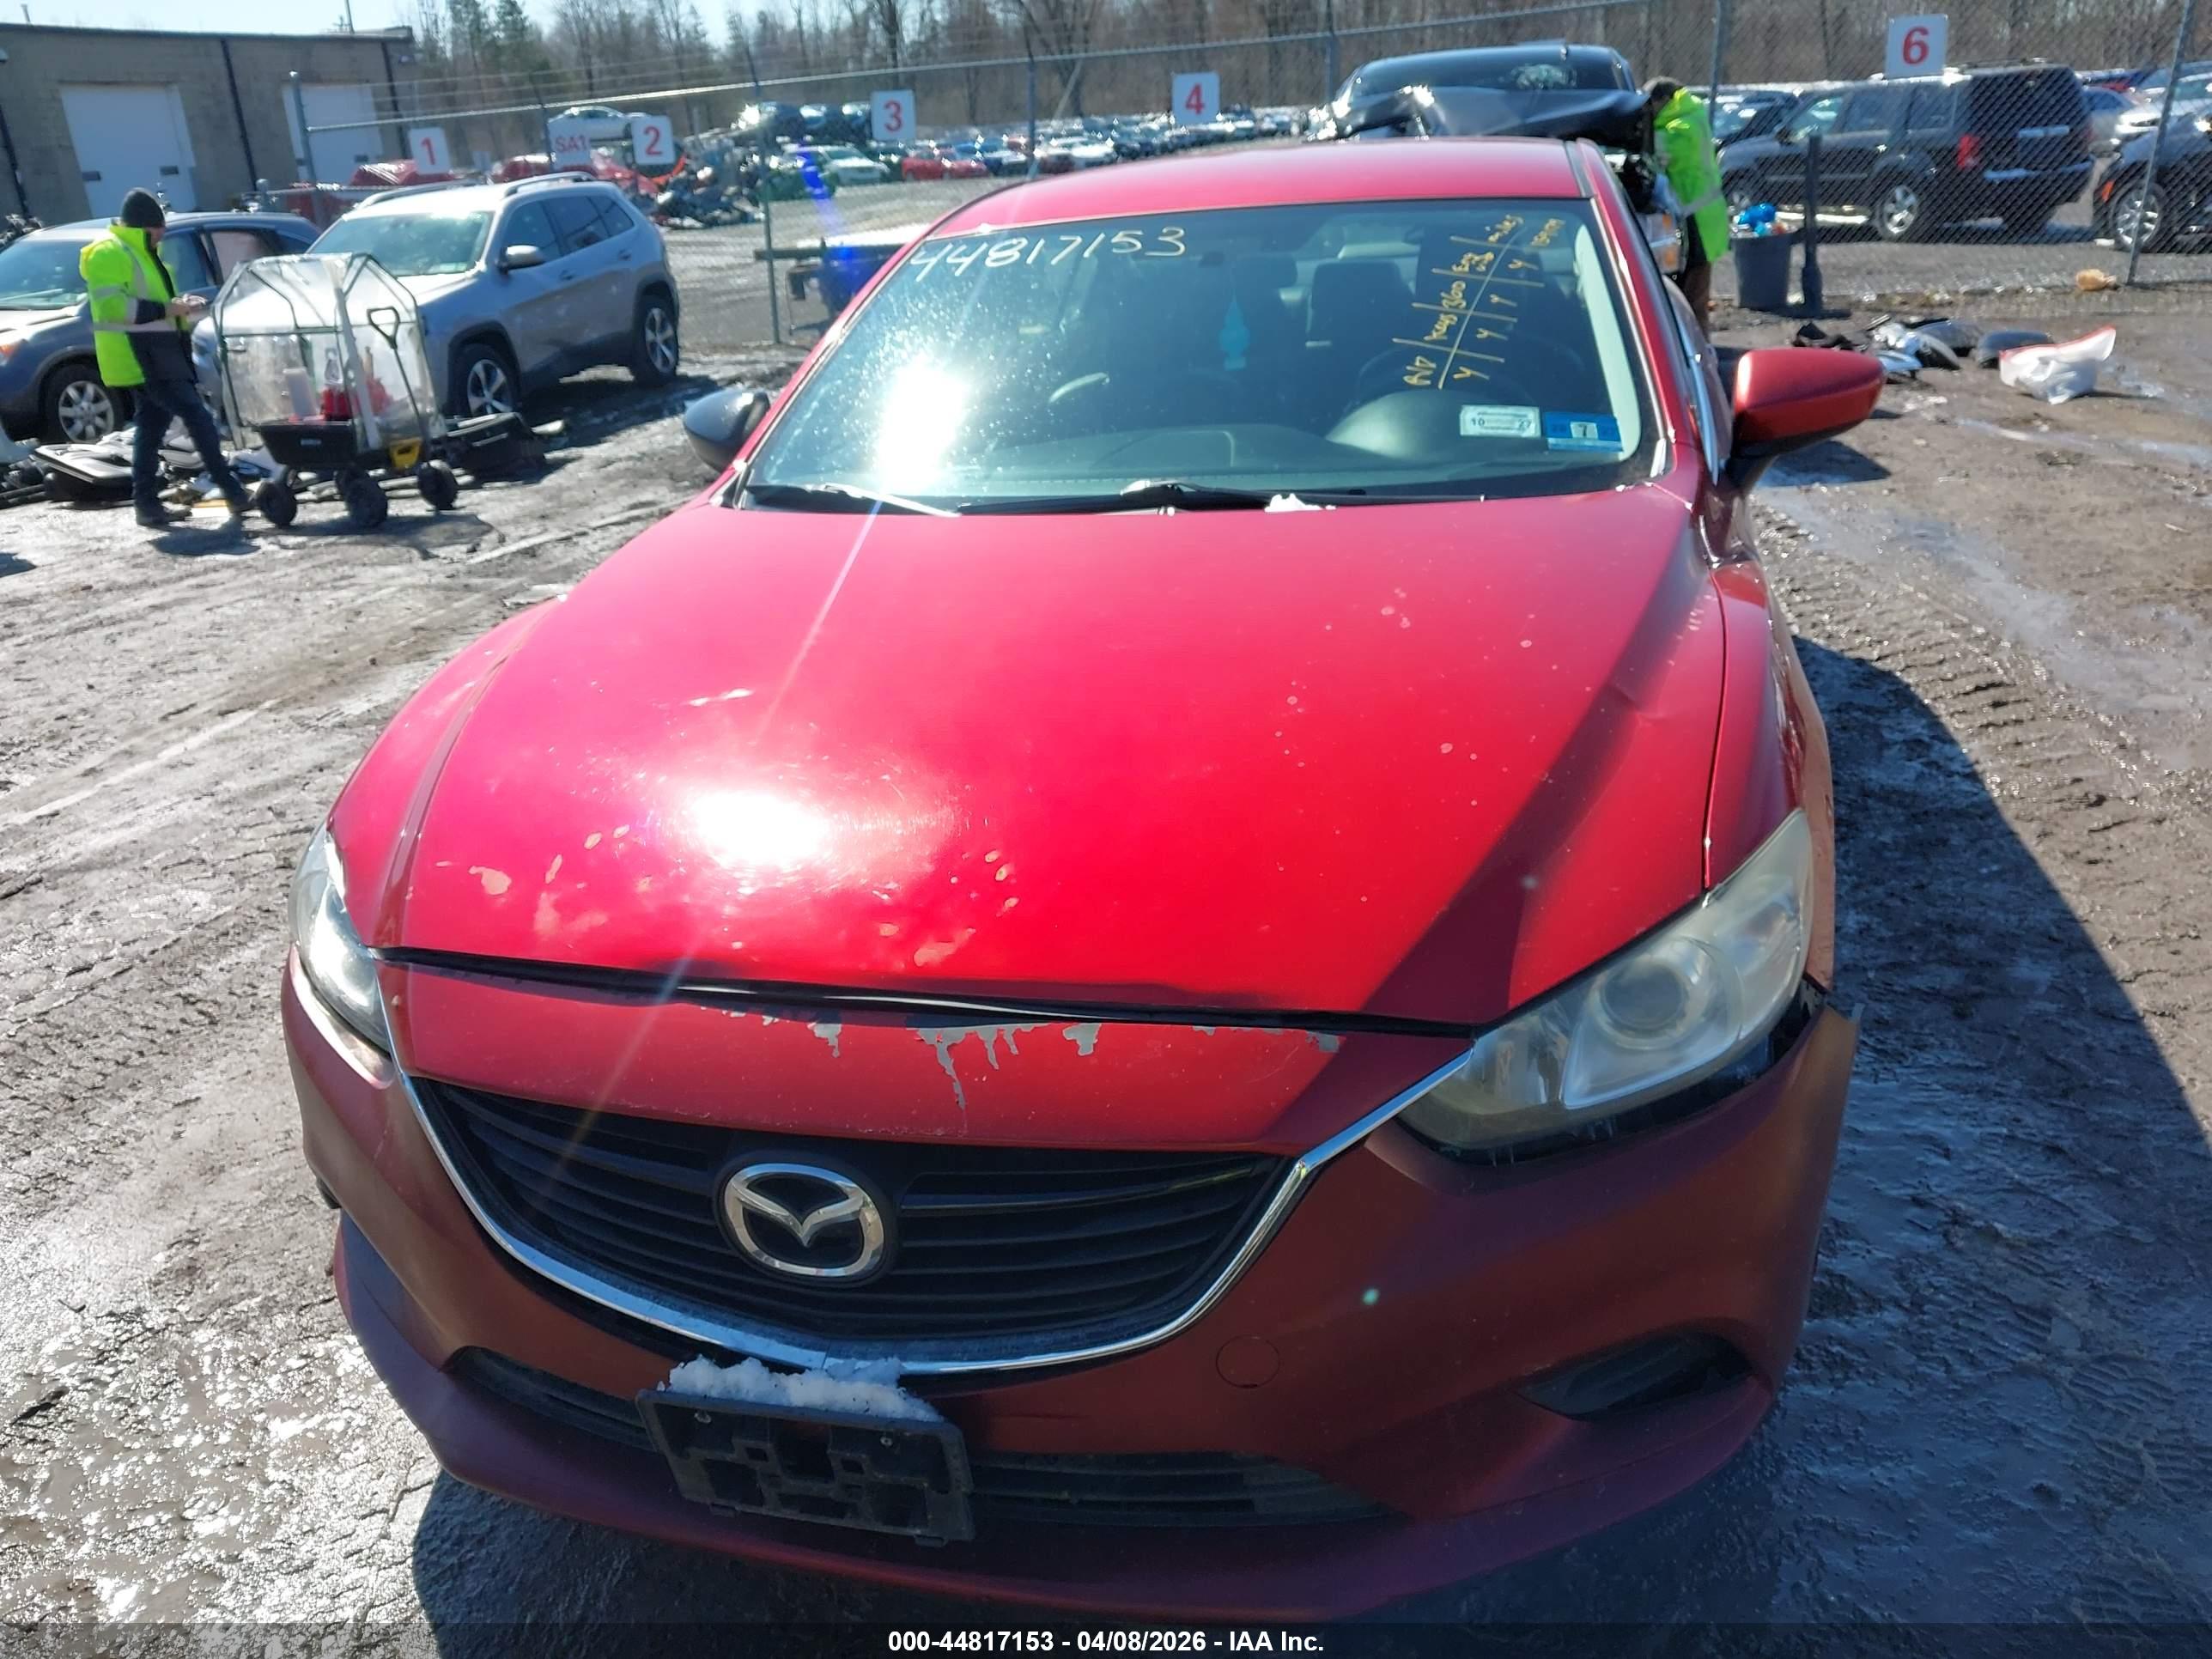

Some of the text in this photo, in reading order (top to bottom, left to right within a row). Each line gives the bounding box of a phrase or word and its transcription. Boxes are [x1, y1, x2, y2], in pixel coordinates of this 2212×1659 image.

[1902, 26, 1929, 65] 6
[1185, 83, 1205, 114] 4
[883, 100, 903, 132] 3
[419, 137, 436, 166] 1
[555, 136, 589, 153] SA1
[643, 125, 663, 156] 2
[910, 226, 1186, 282] 44817153
[1440, 280, 1467, 309] 360
[1471, 418, 1486, 428] 10
[1577, 424, 1589, 438] 7
